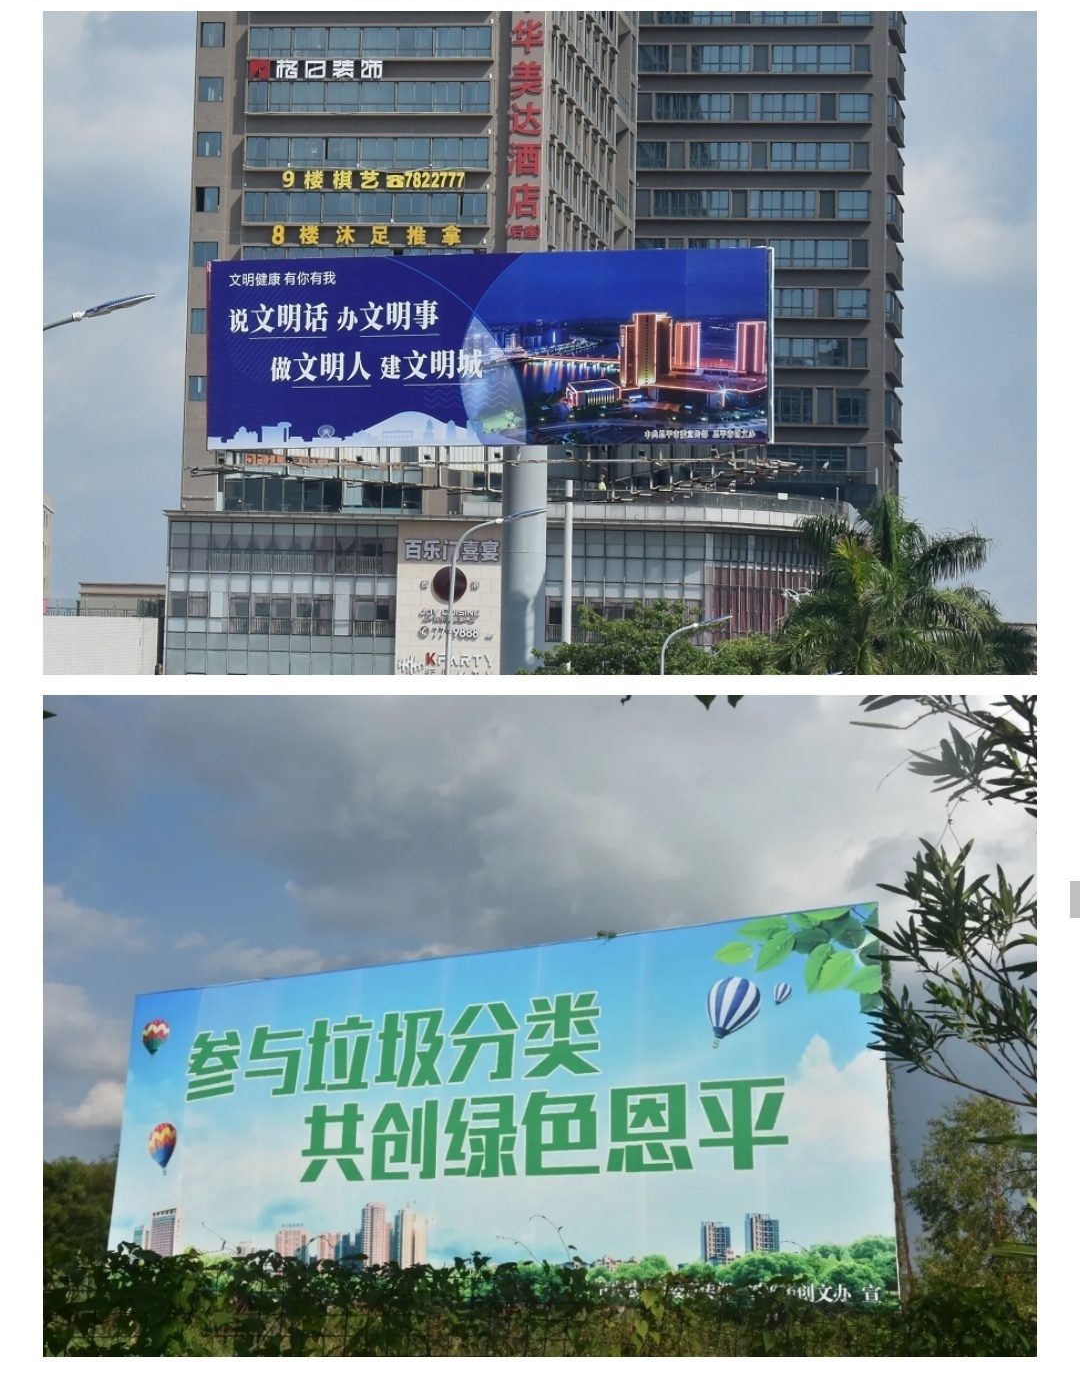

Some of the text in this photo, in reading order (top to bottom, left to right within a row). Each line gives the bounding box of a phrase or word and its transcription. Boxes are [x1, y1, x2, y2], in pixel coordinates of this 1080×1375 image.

[507, 19, 544, 218] 华美达酒店
[404, 171, 465, 189] 7822777
[271, 224, 463, 246] 8楼沐足推拿
[229, 271, 337, 287] 文明健康 有你有我
[229, 299, 439, 334] 说文明话 办文明事
[270, 349, 484, 382] 做文明人 建文明城
[404, 539, 500, 562] 百乐门喜宴
[433, 626, 479, 638] 779888
[185, 990, 602, 1102] 参与垃圾分类
[299, 1077, 790, 1184] 共创绿色恩平
